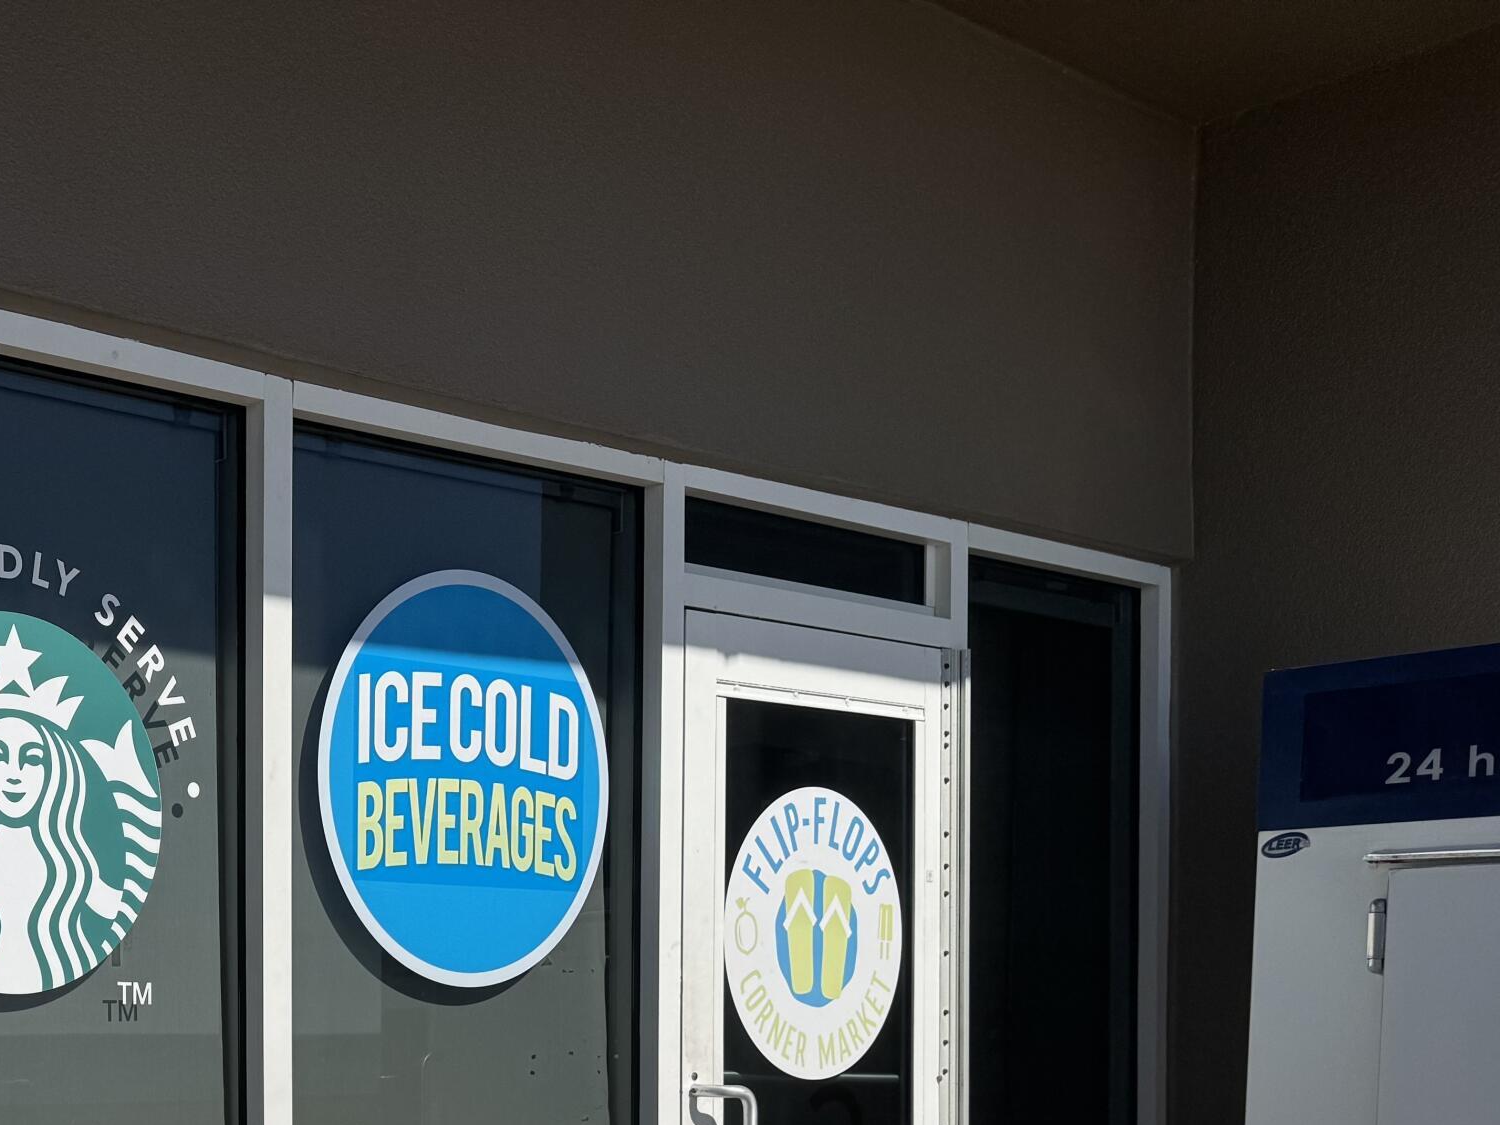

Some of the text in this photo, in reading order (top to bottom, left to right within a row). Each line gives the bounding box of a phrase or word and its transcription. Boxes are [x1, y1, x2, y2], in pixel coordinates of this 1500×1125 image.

[93, 593, 197, 747] SERVE
[357, 671, 580, 781] ICE COLD
[1384, 748, 1444, 785] 24
[356, 777, 577, 882] BEVERAGES
[742, 797, 891, 895] FLIP-FLOPS
[1267, 837, 1301, 852] LEER
[117, 981, 153, 1005] TM
[739, 969, 892, 1070] CORNER MARKET
